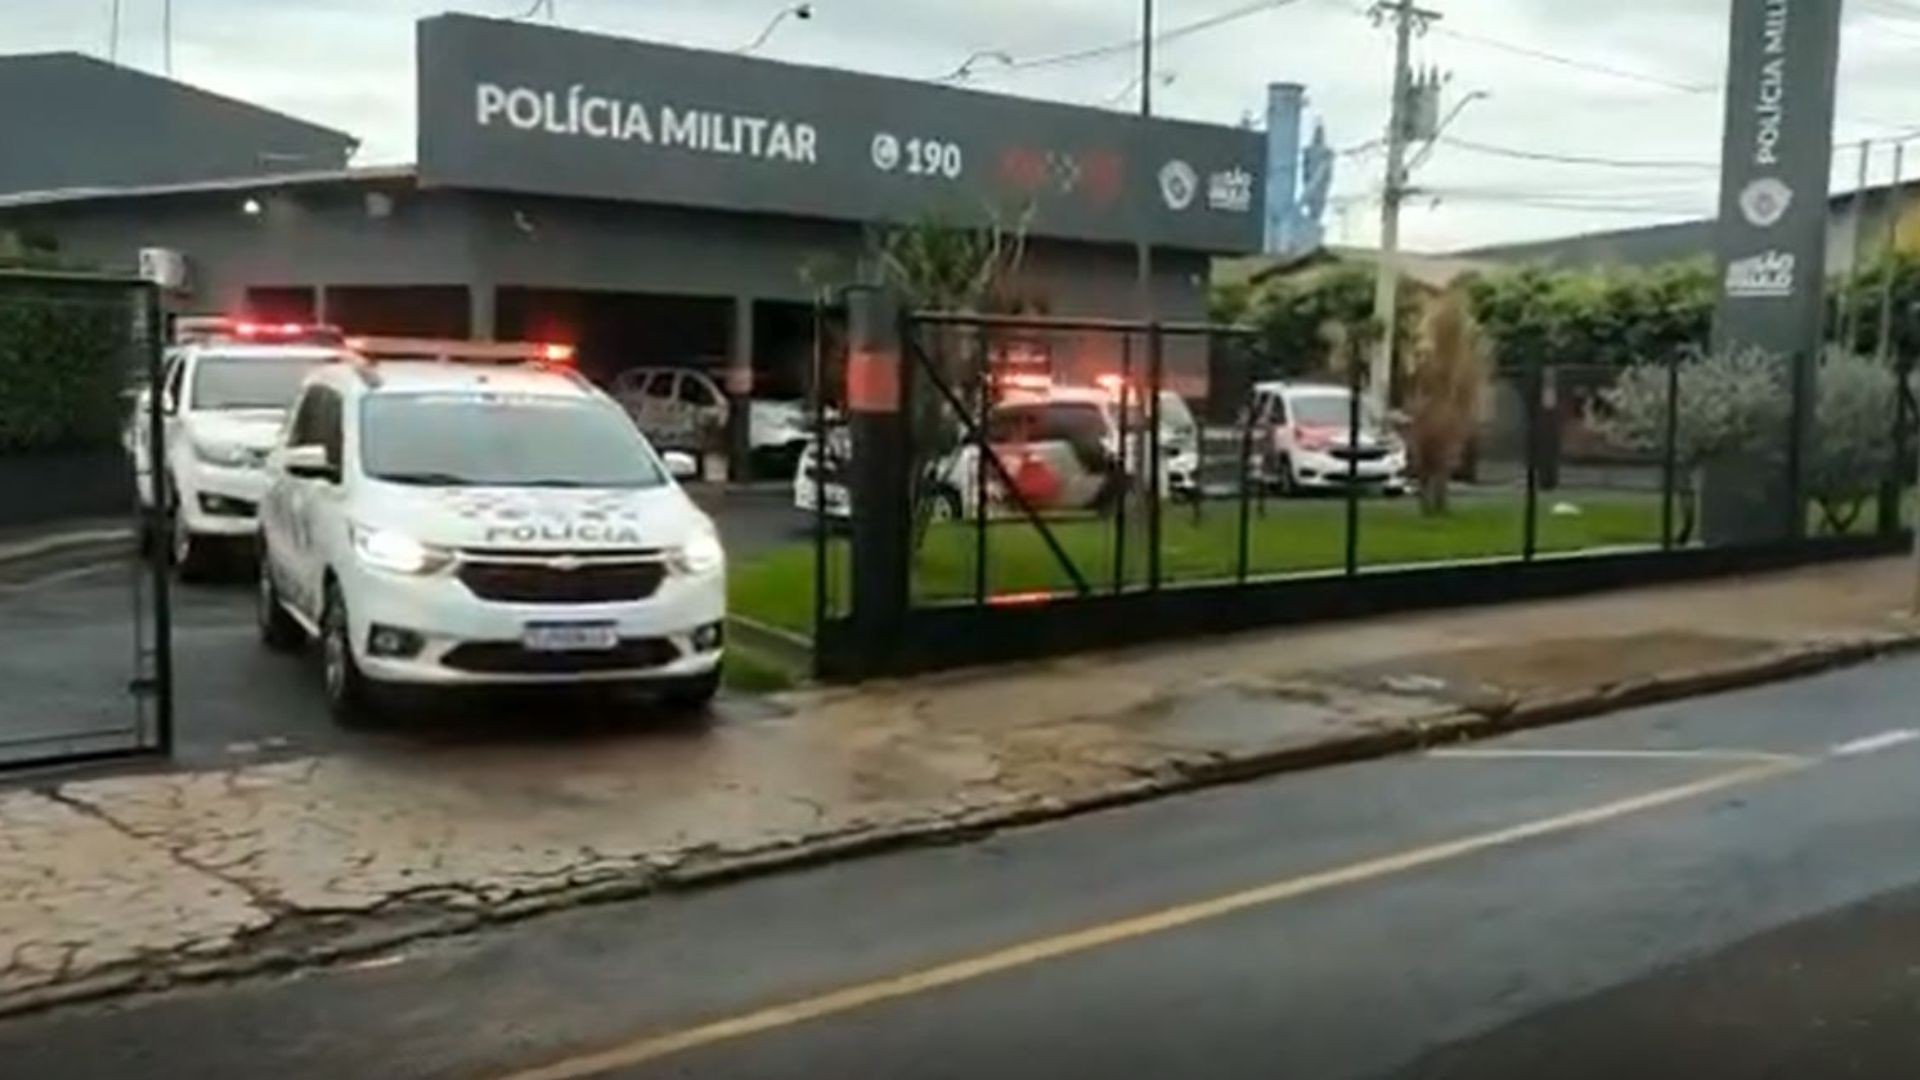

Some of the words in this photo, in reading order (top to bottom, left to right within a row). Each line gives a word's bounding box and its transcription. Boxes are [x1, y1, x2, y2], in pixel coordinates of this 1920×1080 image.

[477, 83, 653, 143] POLÍCIA
[660, 105, 817, 163] MILITAR
[1756, 58, 1784, 164] POLÍCIA
[905, 138, 961, 179] 190
